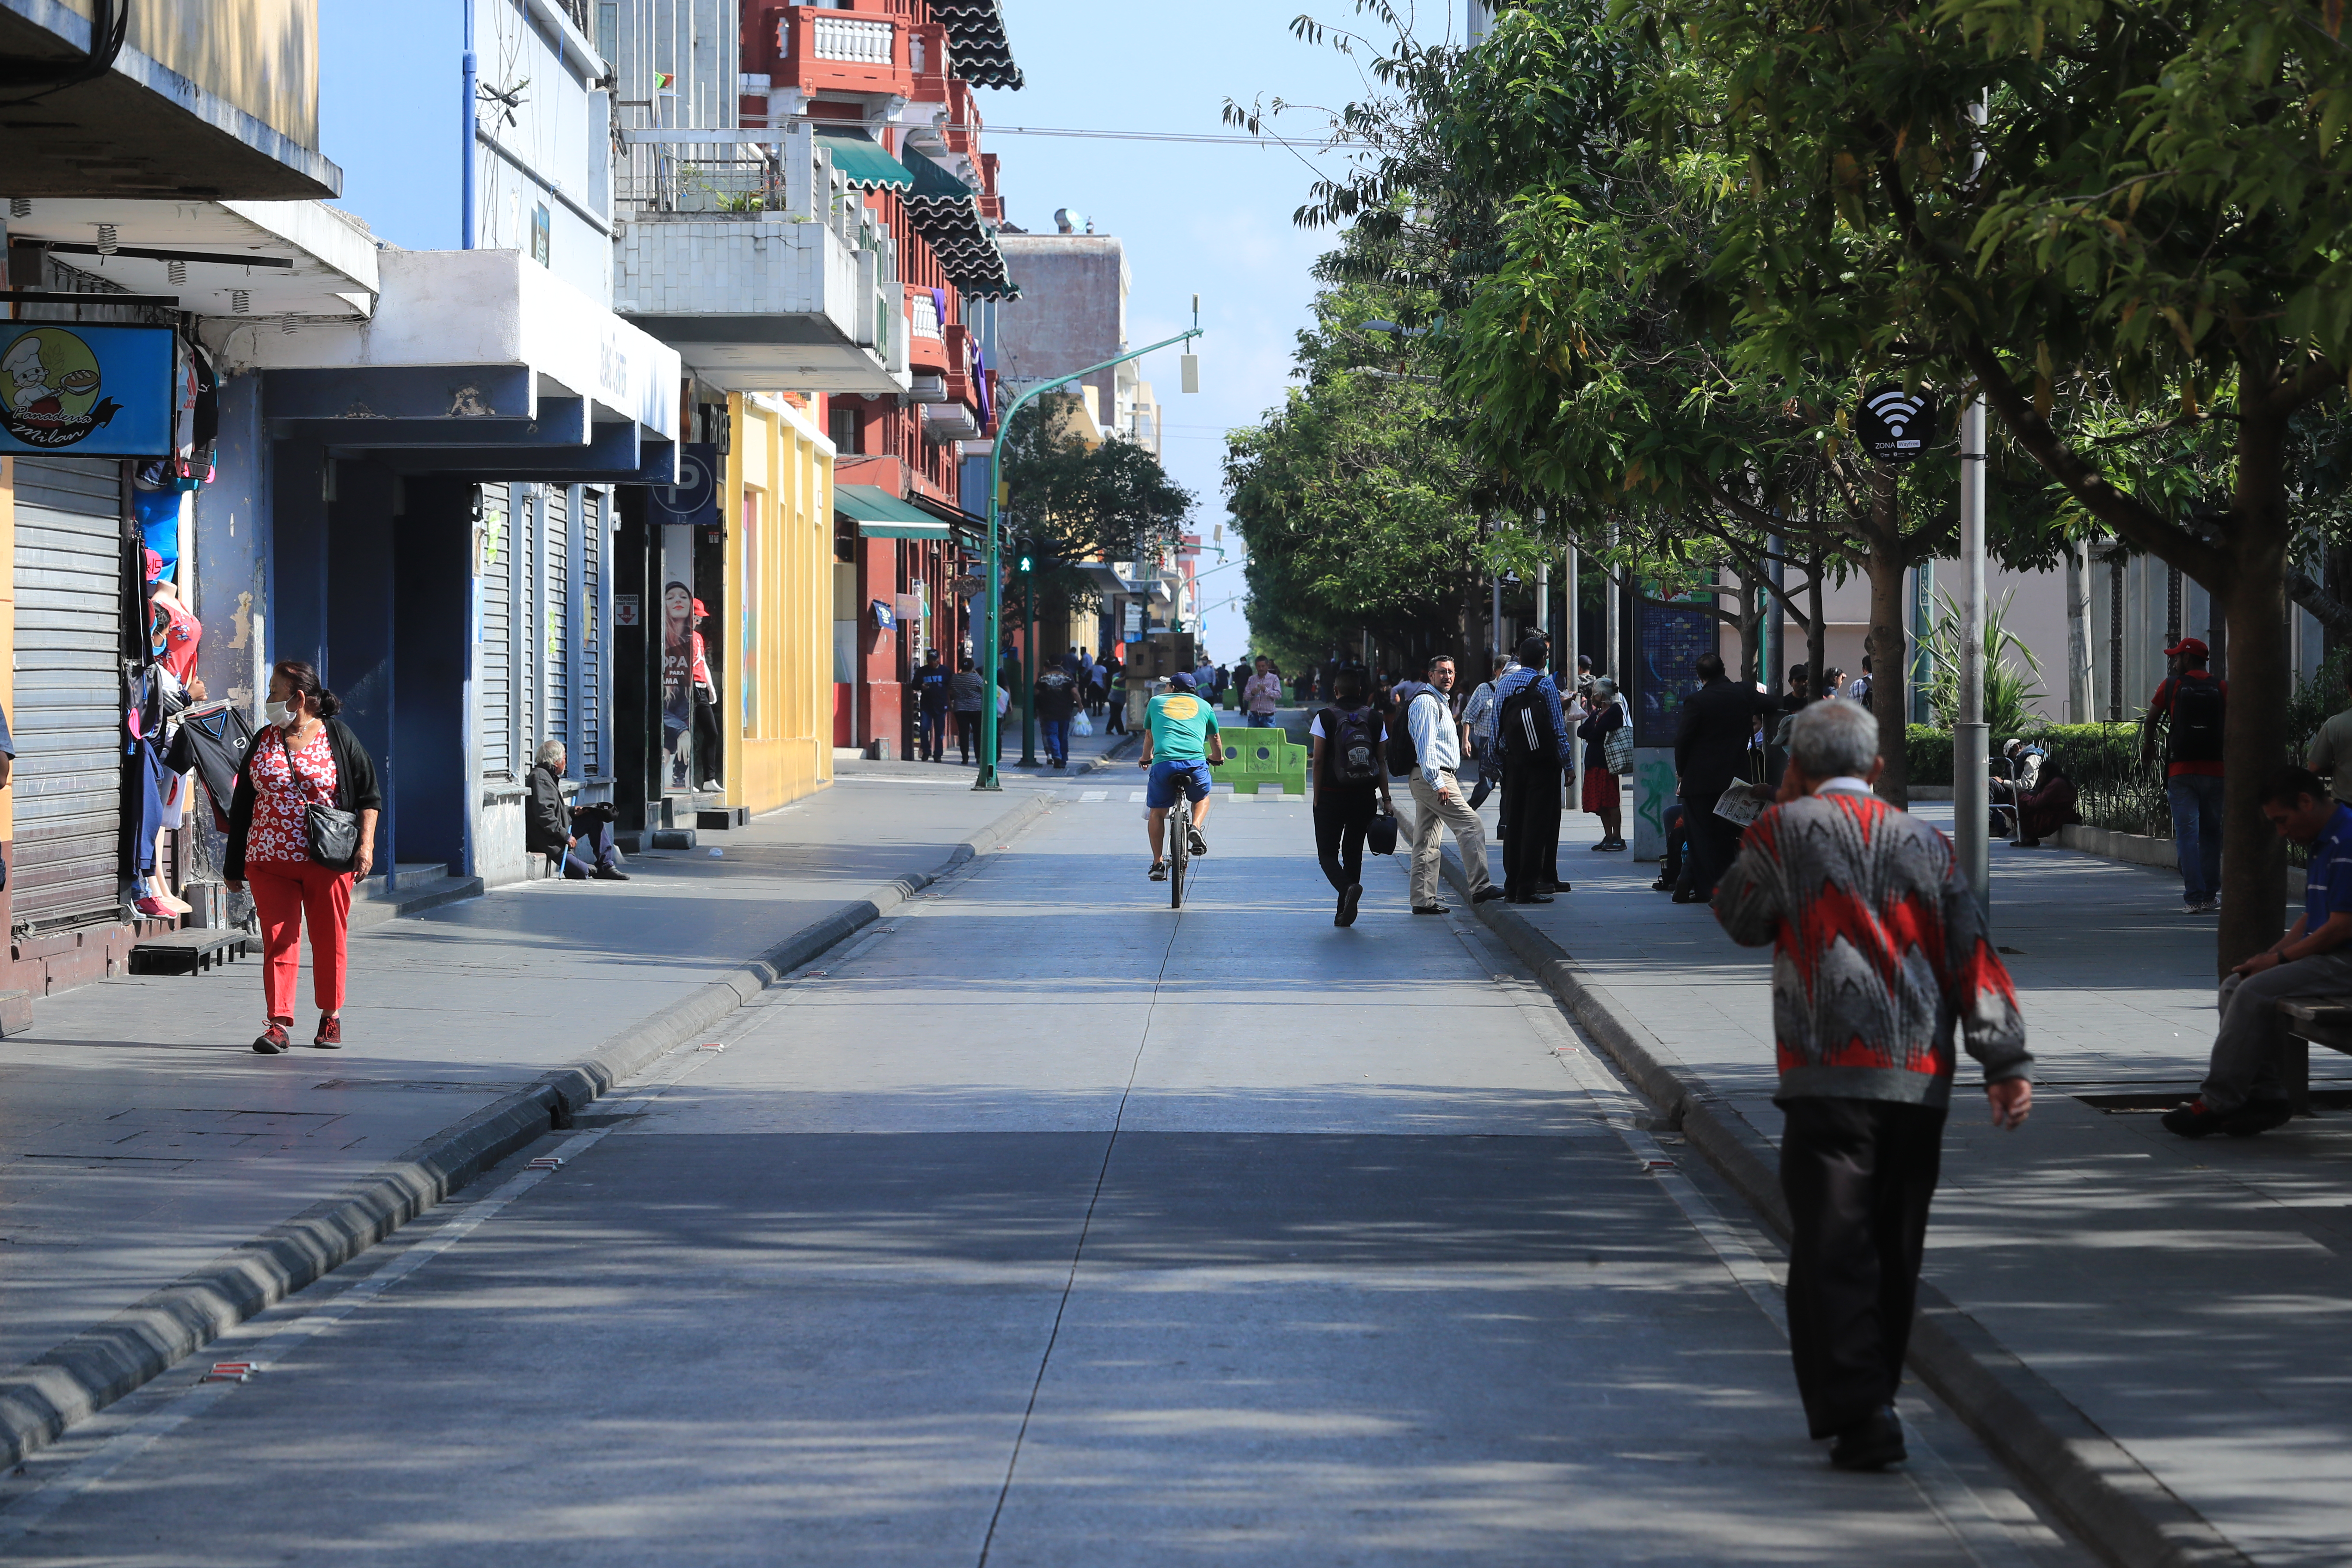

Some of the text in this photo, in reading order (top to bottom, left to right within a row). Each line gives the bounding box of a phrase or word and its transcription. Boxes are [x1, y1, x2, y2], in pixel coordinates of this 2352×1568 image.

[12, 405, 92, 423] Panaderia
[668, 464, 700, 504] P
[677, 515, 687, 523] 12
